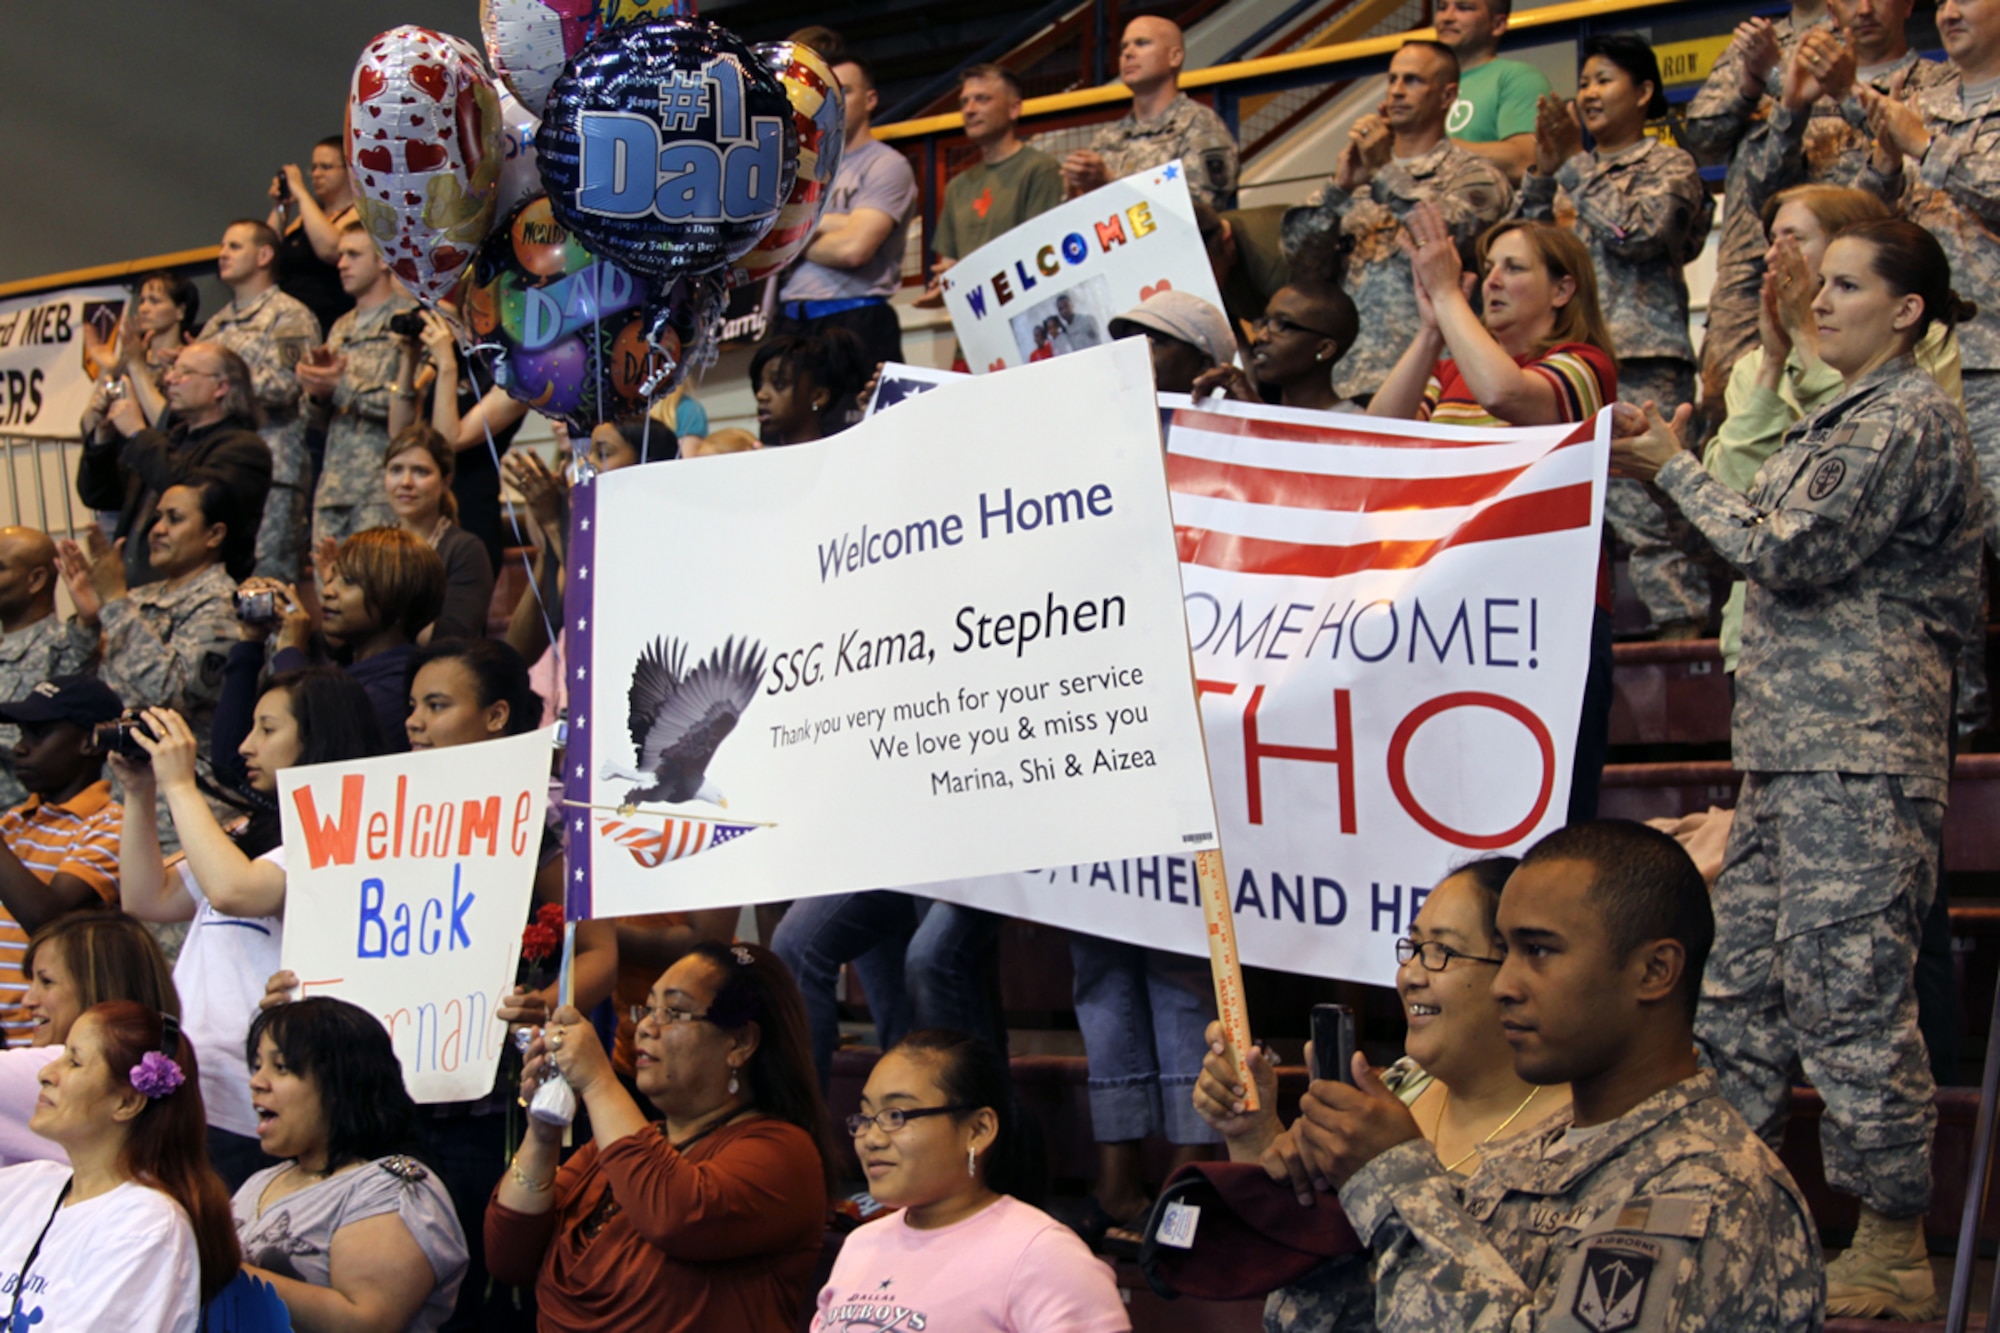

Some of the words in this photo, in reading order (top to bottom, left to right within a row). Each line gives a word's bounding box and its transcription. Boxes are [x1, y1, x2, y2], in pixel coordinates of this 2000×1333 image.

[658, 53, 747, 143] #1
[1664, 52, 1699, 77] ROW
[576, 112, 785, 223] Dad
[966, 201, 1157, 320] WELCOME
[20, 302, 72, 346] MEB
[522, 260, 633, 348] DAD
[0, 367, 44, 426] RS
[818, 513, 963, 583] Welcome
[979, 482, 1113, 538] Home
[767, 642, 824, 696] SSG.
[834, 628, 936, 677] Kama,
[952, 592, 1126, 658] Stephen
[770, 722, 811, 748] Thank
[812, 717, 841, 745] you
[847, 707, 886, 732] very
[893, 691, 950, 722] much
[958, 686, 989, 711] for
[998, 679, 1050, 713] your
[1060, 665, 1144, 697] service
[870, 736, 909, 760] We
[916, 730, 961, 755] love
[969, 725, 1009, 754] you
[1018, 716, 1036, 740] &
[1045, 710, 1098, 738] miss
[1106, 704, 1149, 733] you
[931, 767, 1014, 795] Marina,
[1022, 757, 1056, 783] Shi
[1065, 753, 1083, 777] &
[1092, 747, 1157, 774] Aizea
[292, 774, 531, 870] Welcome
[357, 862, 476, 959] Back
[1234, 869, 1347, 926] AND
[1594, 1236, 1656, 1252] AIRBORNE
